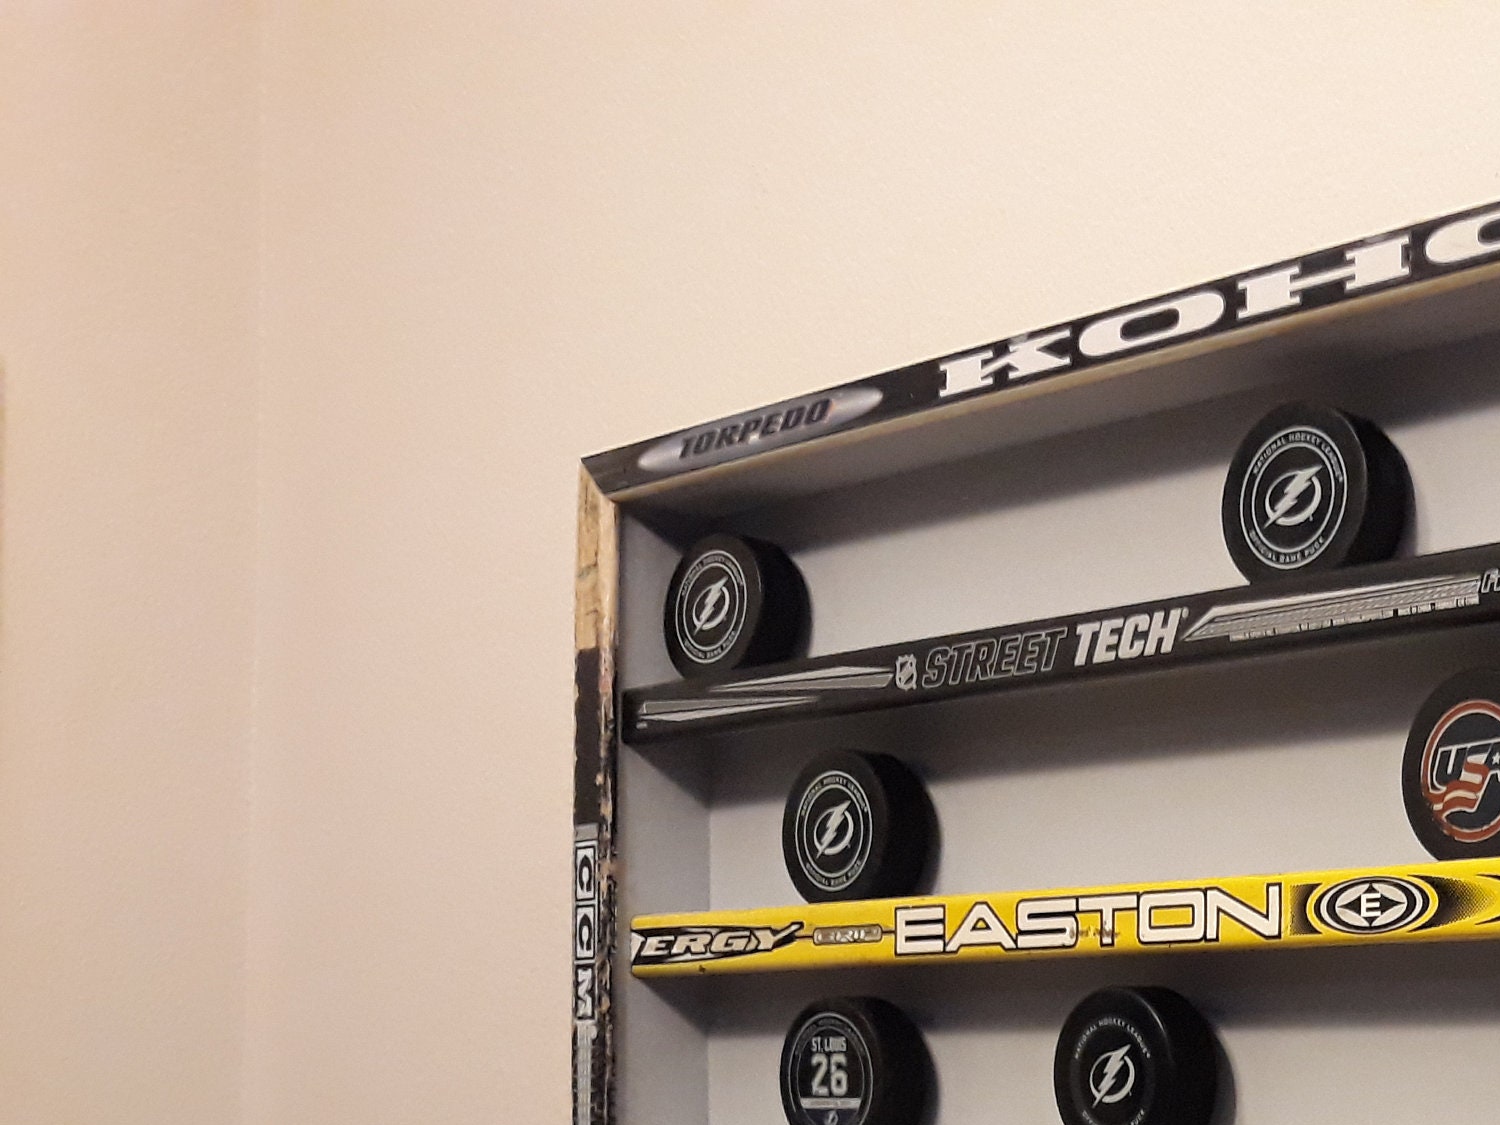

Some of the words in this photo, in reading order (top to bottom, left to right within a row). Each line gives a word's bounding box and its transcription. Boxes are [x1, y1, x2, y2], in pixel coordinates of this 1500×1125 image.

[678, 398, 835, 459] TORPEDO
[921, 627, 1068, 689] STREET
[1074, 607, 1184, 667] TECH
[575, 846, 595, 1019] CCM
[894, 882, 1283, 956] EASTON
[810, 1052, 848, 1096] 26
